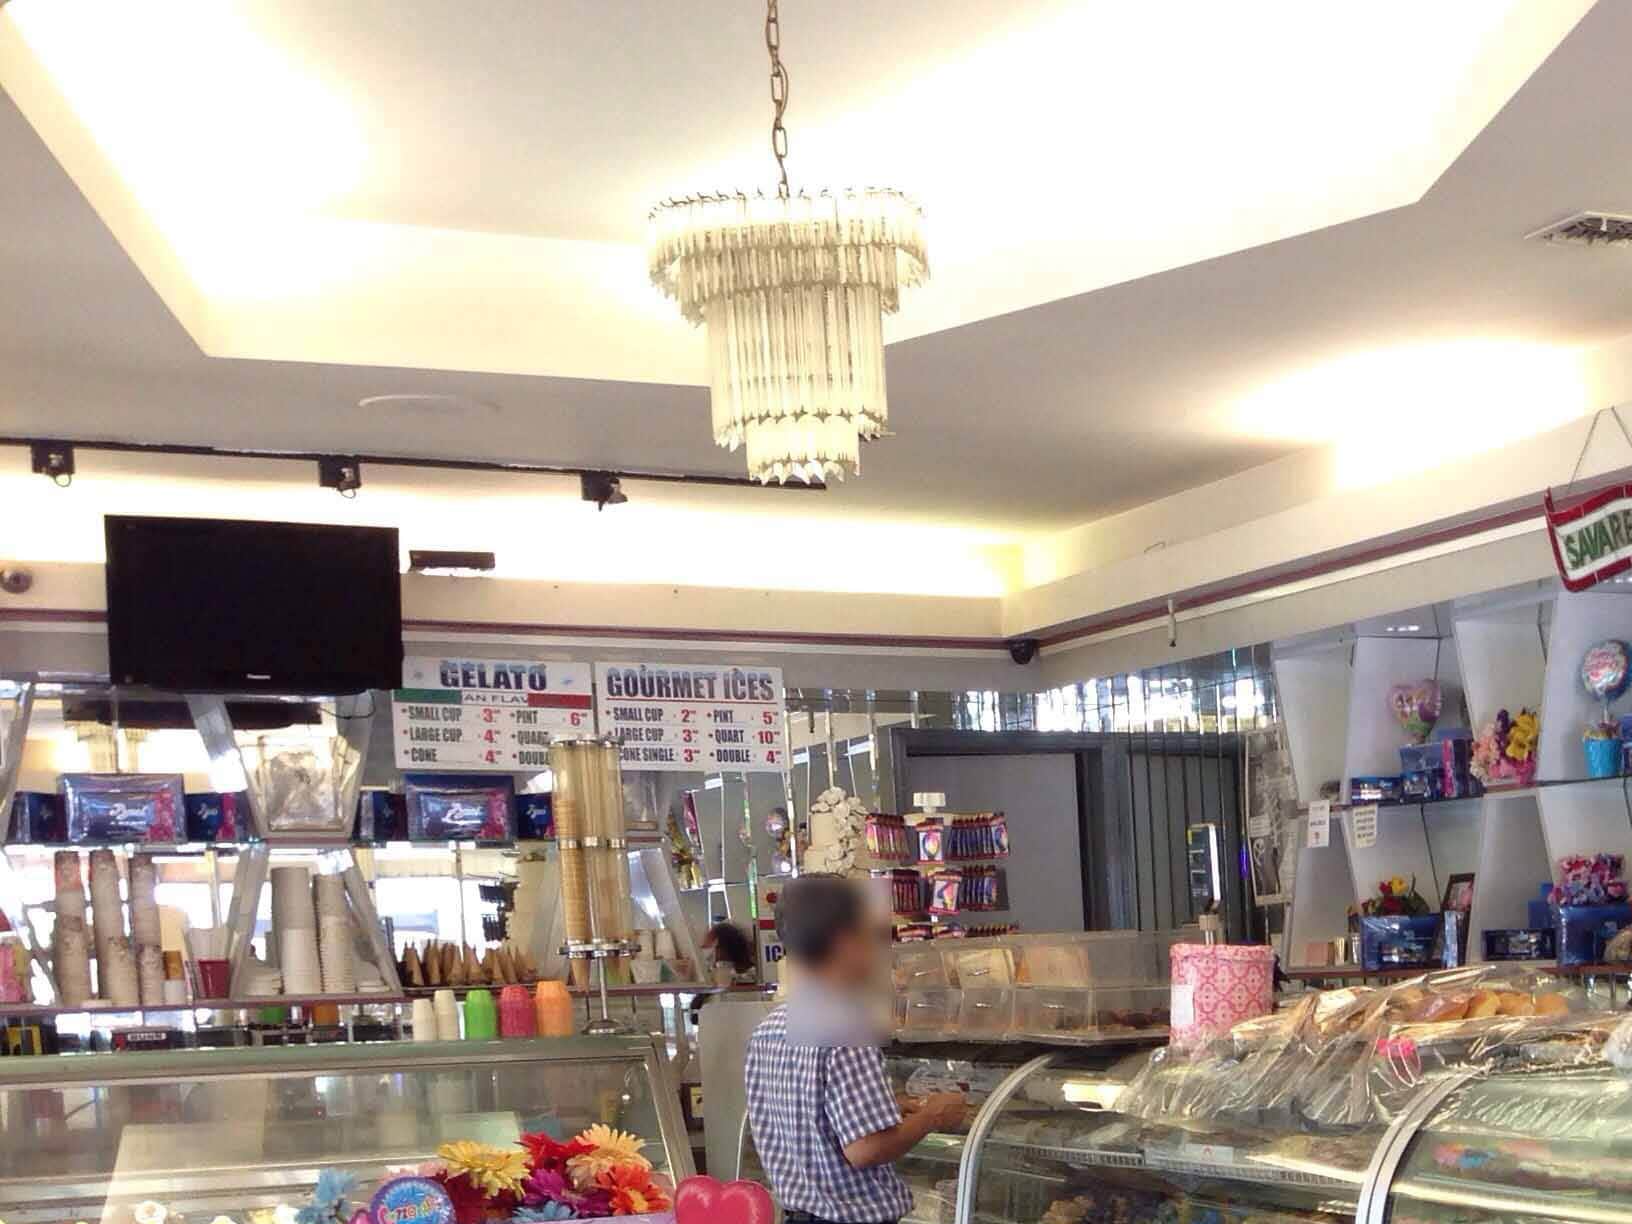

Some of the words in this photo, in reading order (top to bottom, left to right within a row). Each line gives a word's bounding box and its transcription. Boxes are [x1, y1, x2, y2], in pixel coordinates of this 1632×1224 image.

[440, 660, 547, 691] GELATO
[607, 666, 717, 699] GOURMET
[724, 670, 774, 701] ICES
[408, 707, 441, 722] SMALL
[443, 708, 462, 722] CUP
[516, 710, 538, 724] PINT
[614, 708, 642, 722] SMALL
[645, 708, 663, 722] CUP
[714, 710, 734, 723] PINT
[410, 728, 440, 743] LARGE
[443, 729, 462, 743] CUP
[645, 728, 664, 741] CUP
[715, 729, 744, 744] QUART
[411, 747, 438, 763] CONE
[519, 751, 550, 765] DOUBL
[642, 747, 676, 761] SINGLE
[716, 750, 750, 763] DOUBLE
